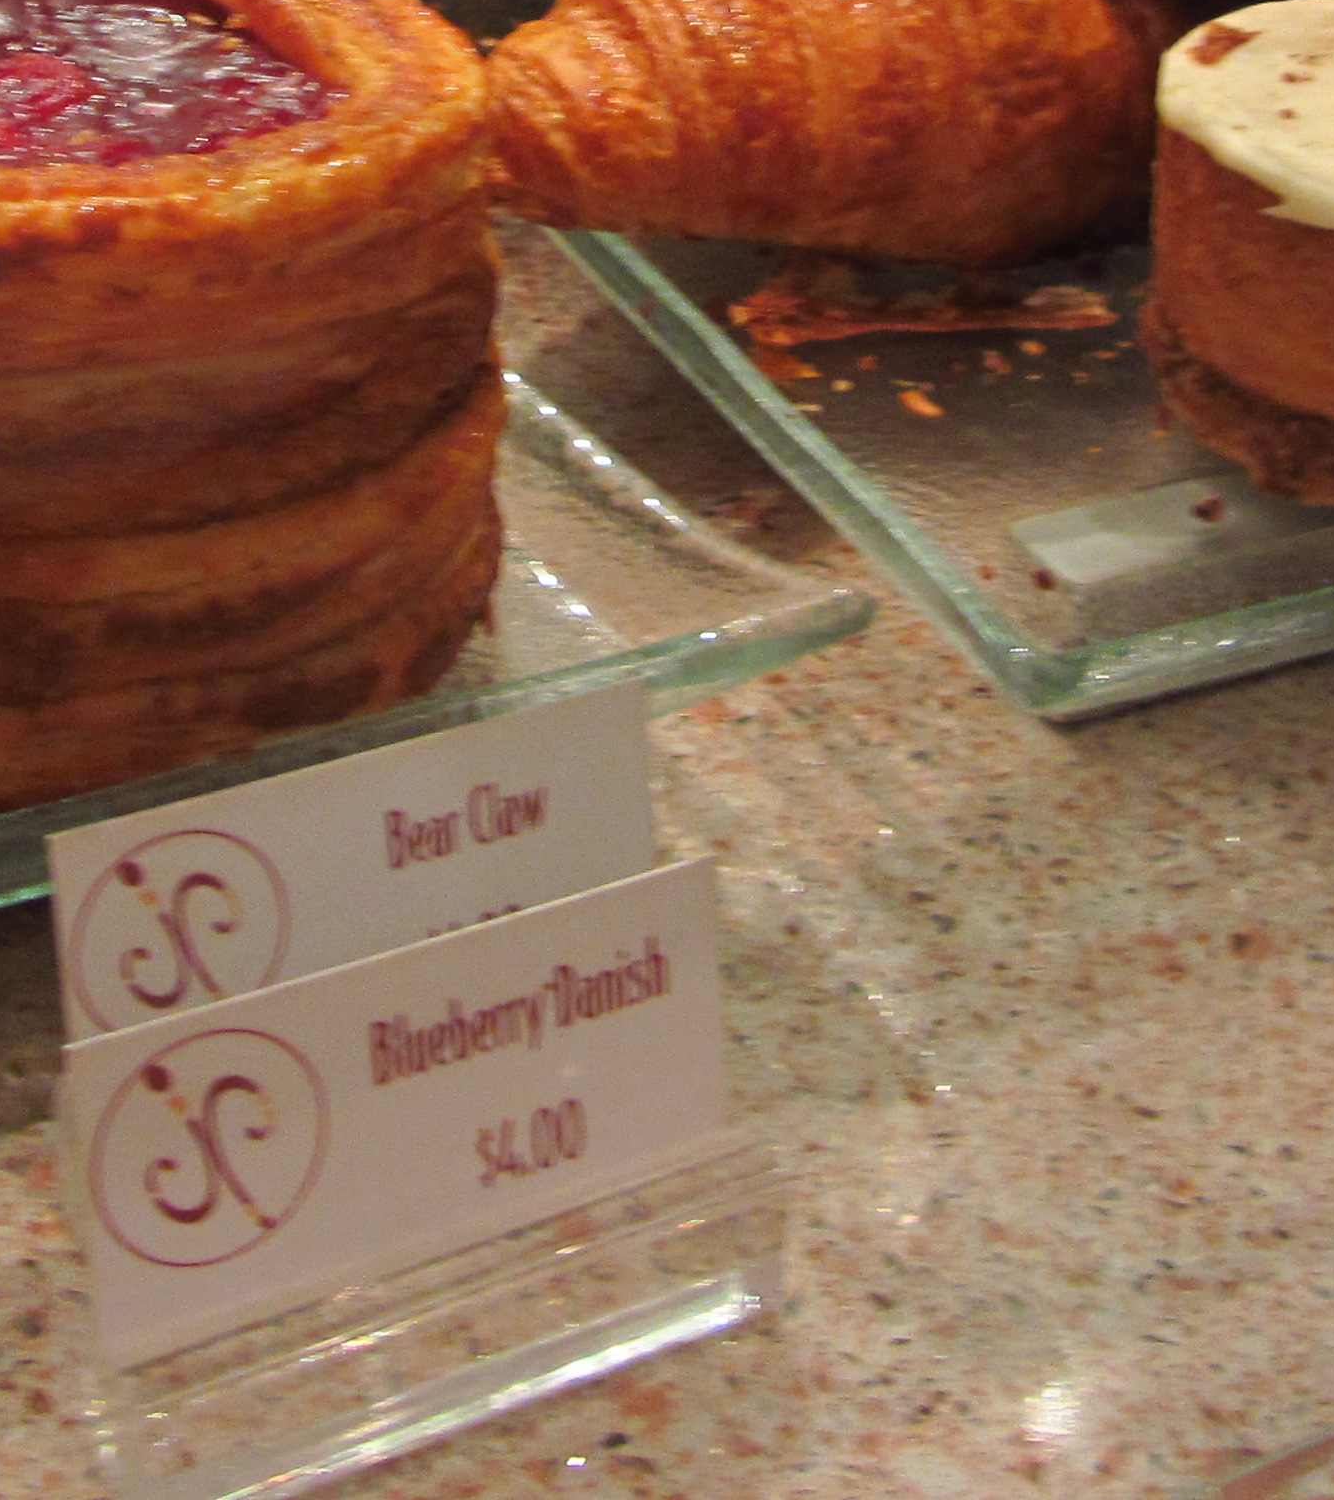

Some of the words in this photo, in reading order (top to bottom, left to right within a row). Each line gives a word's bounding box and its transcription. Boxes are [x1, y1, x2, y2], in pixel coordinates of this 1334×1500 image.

[384, 809, 460, 870] Bear
[467, 783, 549, 844] Claw
[369, 990, 546, 1086] Blueberry
[543, 936, 671, 1028] Danish
[475, 1098, 588, 1188] $4.00
